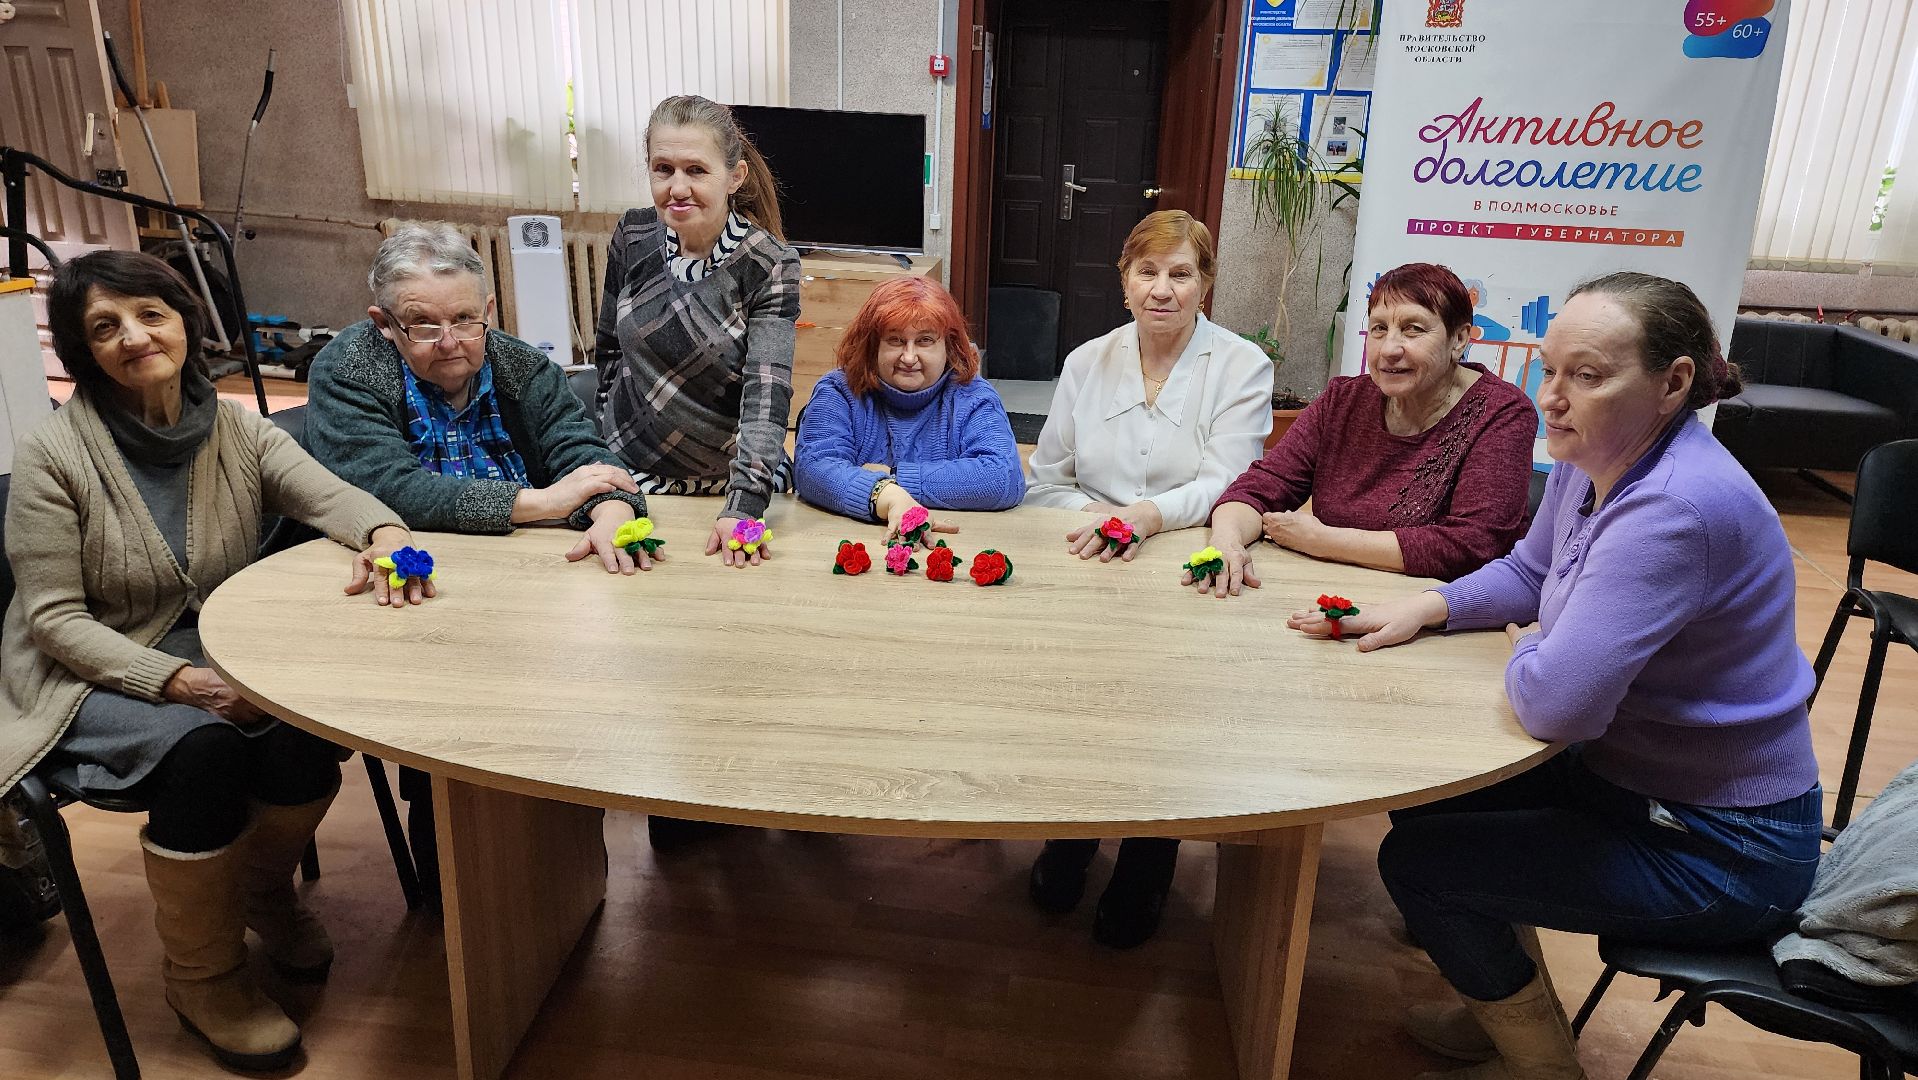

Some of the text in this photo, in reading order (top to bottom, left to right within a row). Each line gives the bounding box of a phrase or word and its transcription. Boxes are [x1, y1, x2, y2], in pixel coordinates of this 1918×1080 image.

[1694, 12, 1727, 27] 55+
[1399, 34, 1486, 42] ПРАВИТЕЛЬСТВО
[1732, 24, 1764, 39] 60+
[1405, 43, 1476, 53] МОСКОВСКОЙ
[1418, 96, 1704, 149] Активное
[1413, 138, 1703, 193] долголетие
[1473, 200, 1619, 216] В ПОДМОСКОВЬЕ
[1414, 221, 1677, 245] ПРОЕКТ ГУБЕРНАТОРА
